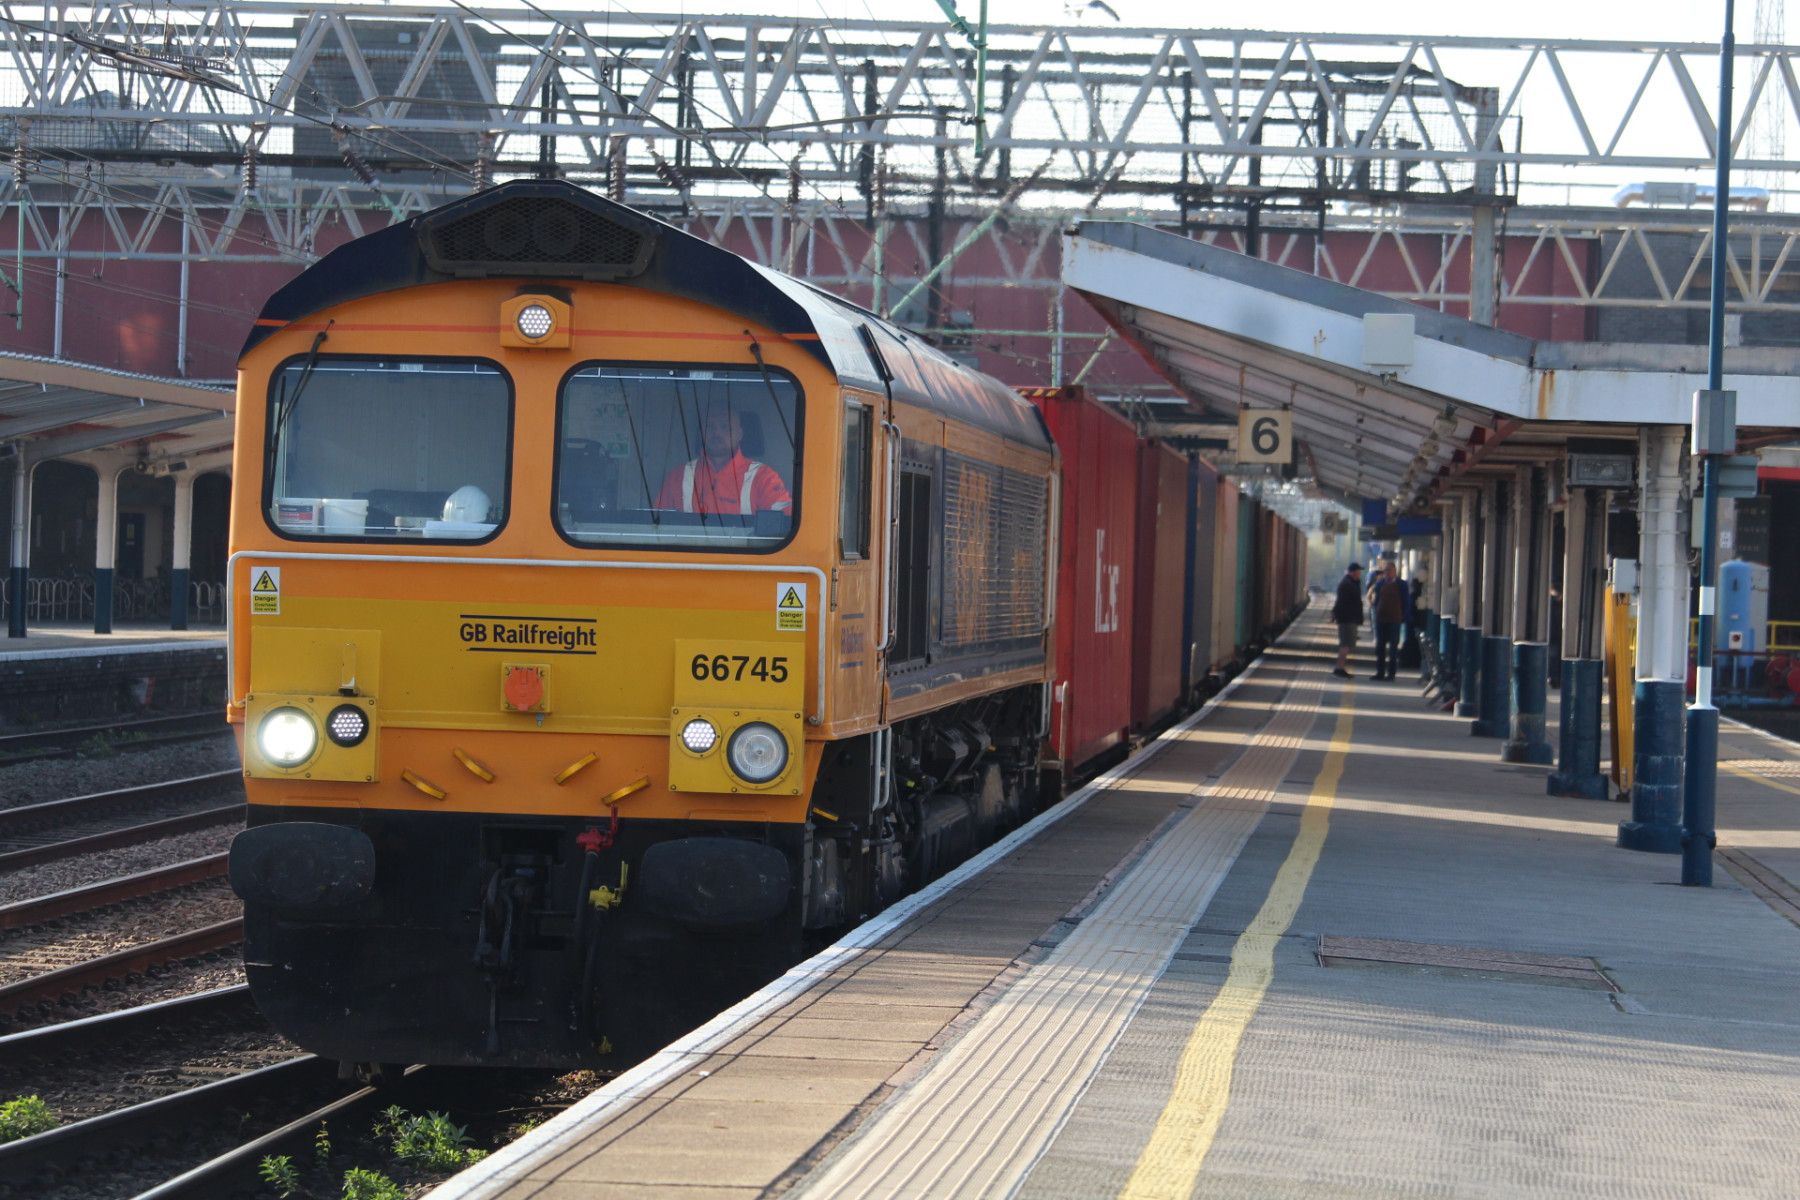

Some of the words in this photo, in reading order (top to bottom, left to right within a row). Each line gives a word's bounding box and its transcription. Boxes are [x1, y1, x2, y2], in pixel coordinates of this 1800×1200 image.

[1251, 417, 1280, 455] 6
[459, 623, 488, 642] GB
[493, 624, 597, 650] Railfreight
[691, 654, 788, 683] 66745
